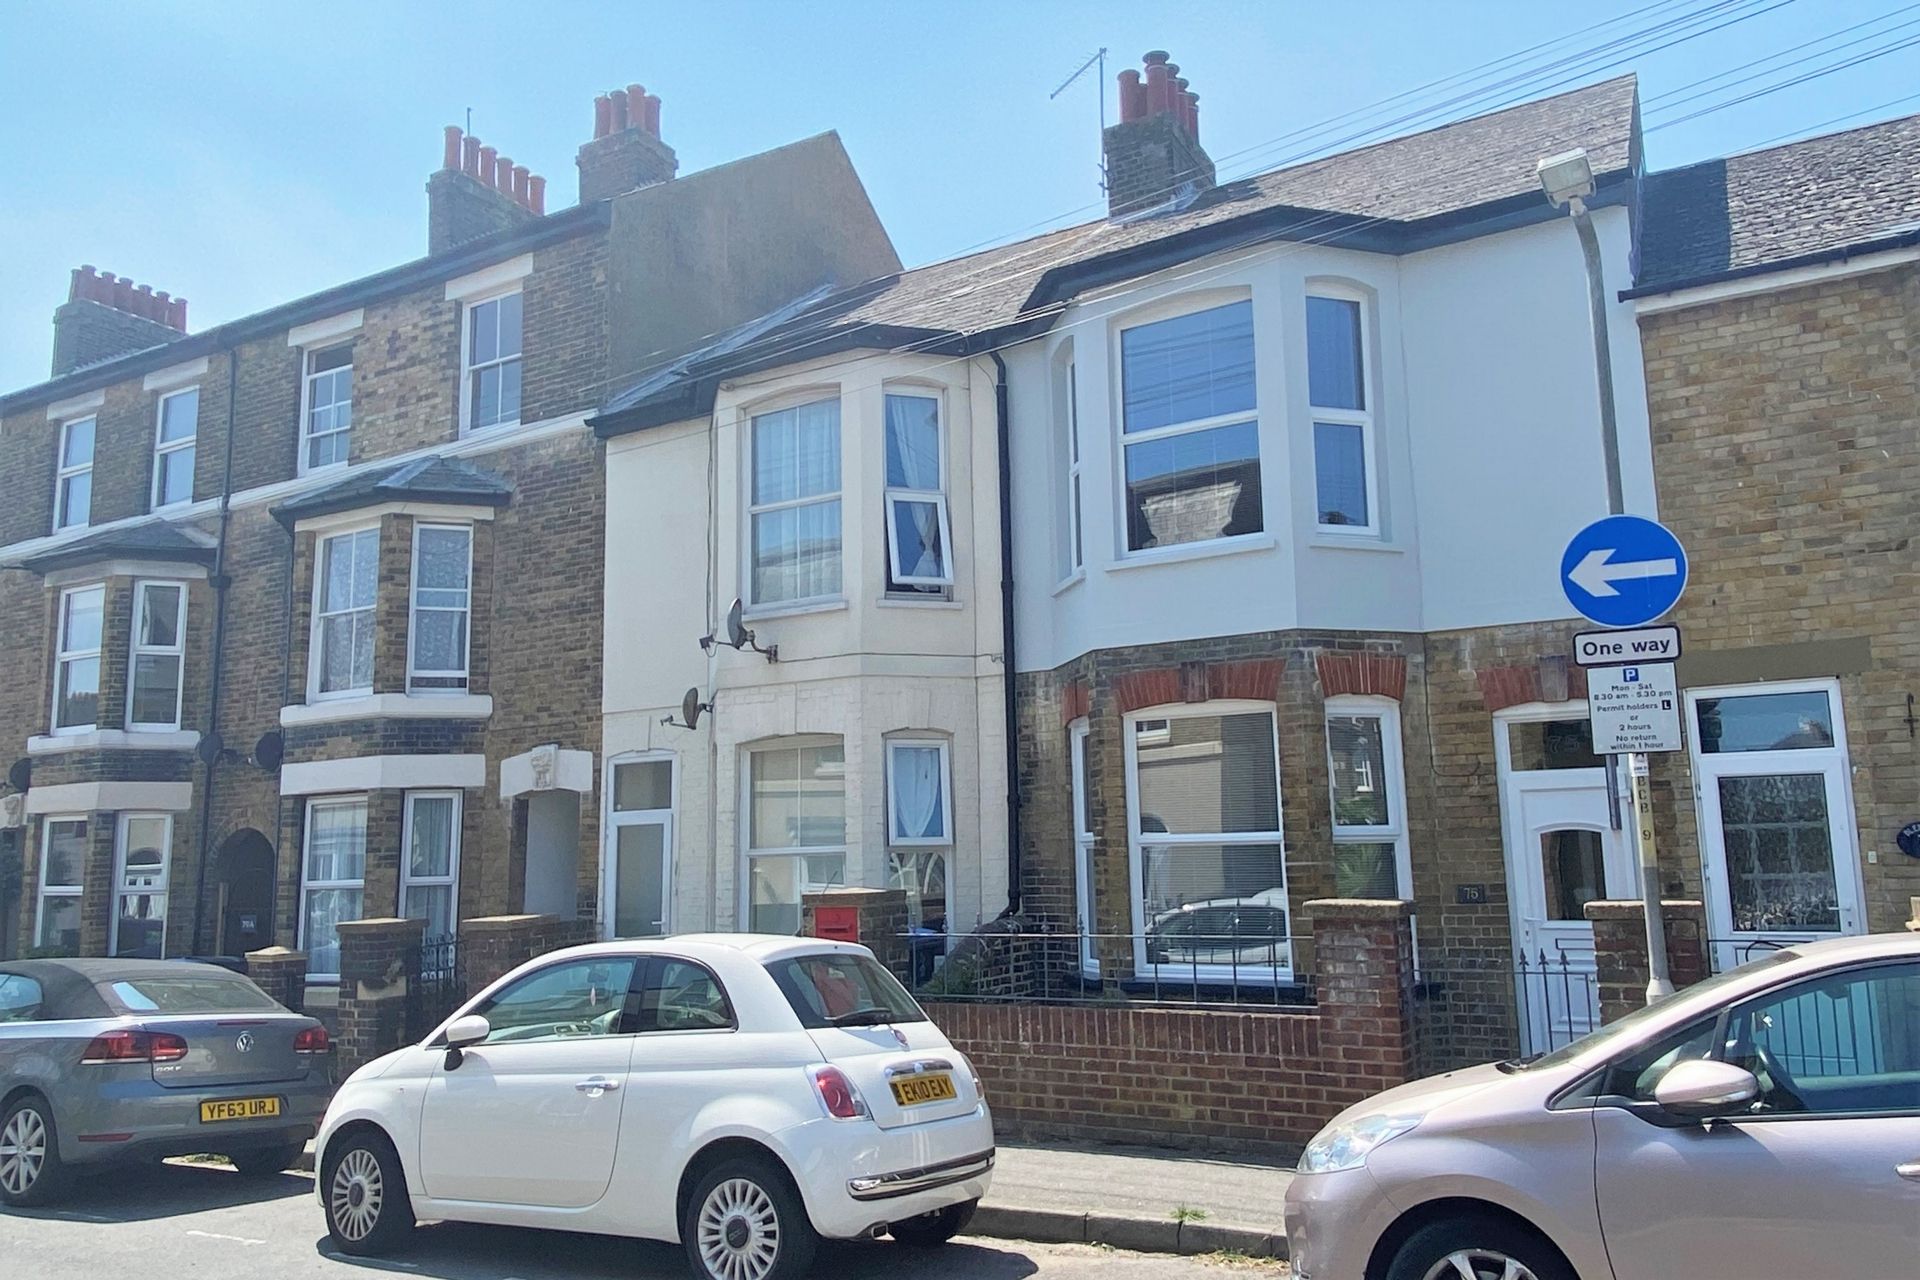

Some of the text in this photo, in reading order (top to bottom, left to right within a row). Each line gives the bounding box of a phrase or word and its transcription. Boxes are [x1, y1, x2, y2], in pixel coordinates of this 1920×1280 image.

[1582, 639, 1670, 656] One way
[1625, 669, 1637, 682] P
[1636, 690, 1656, 698] 5.30
[1597, 704, 1625, 712] Permit
[1626, 703, 1658, 711] holders
[1463, 887, 1479, 900] 75
[901, 1077, 952, 1101] EK10 EAY
[207, 1099, 275, 1118] YF63 URJ
